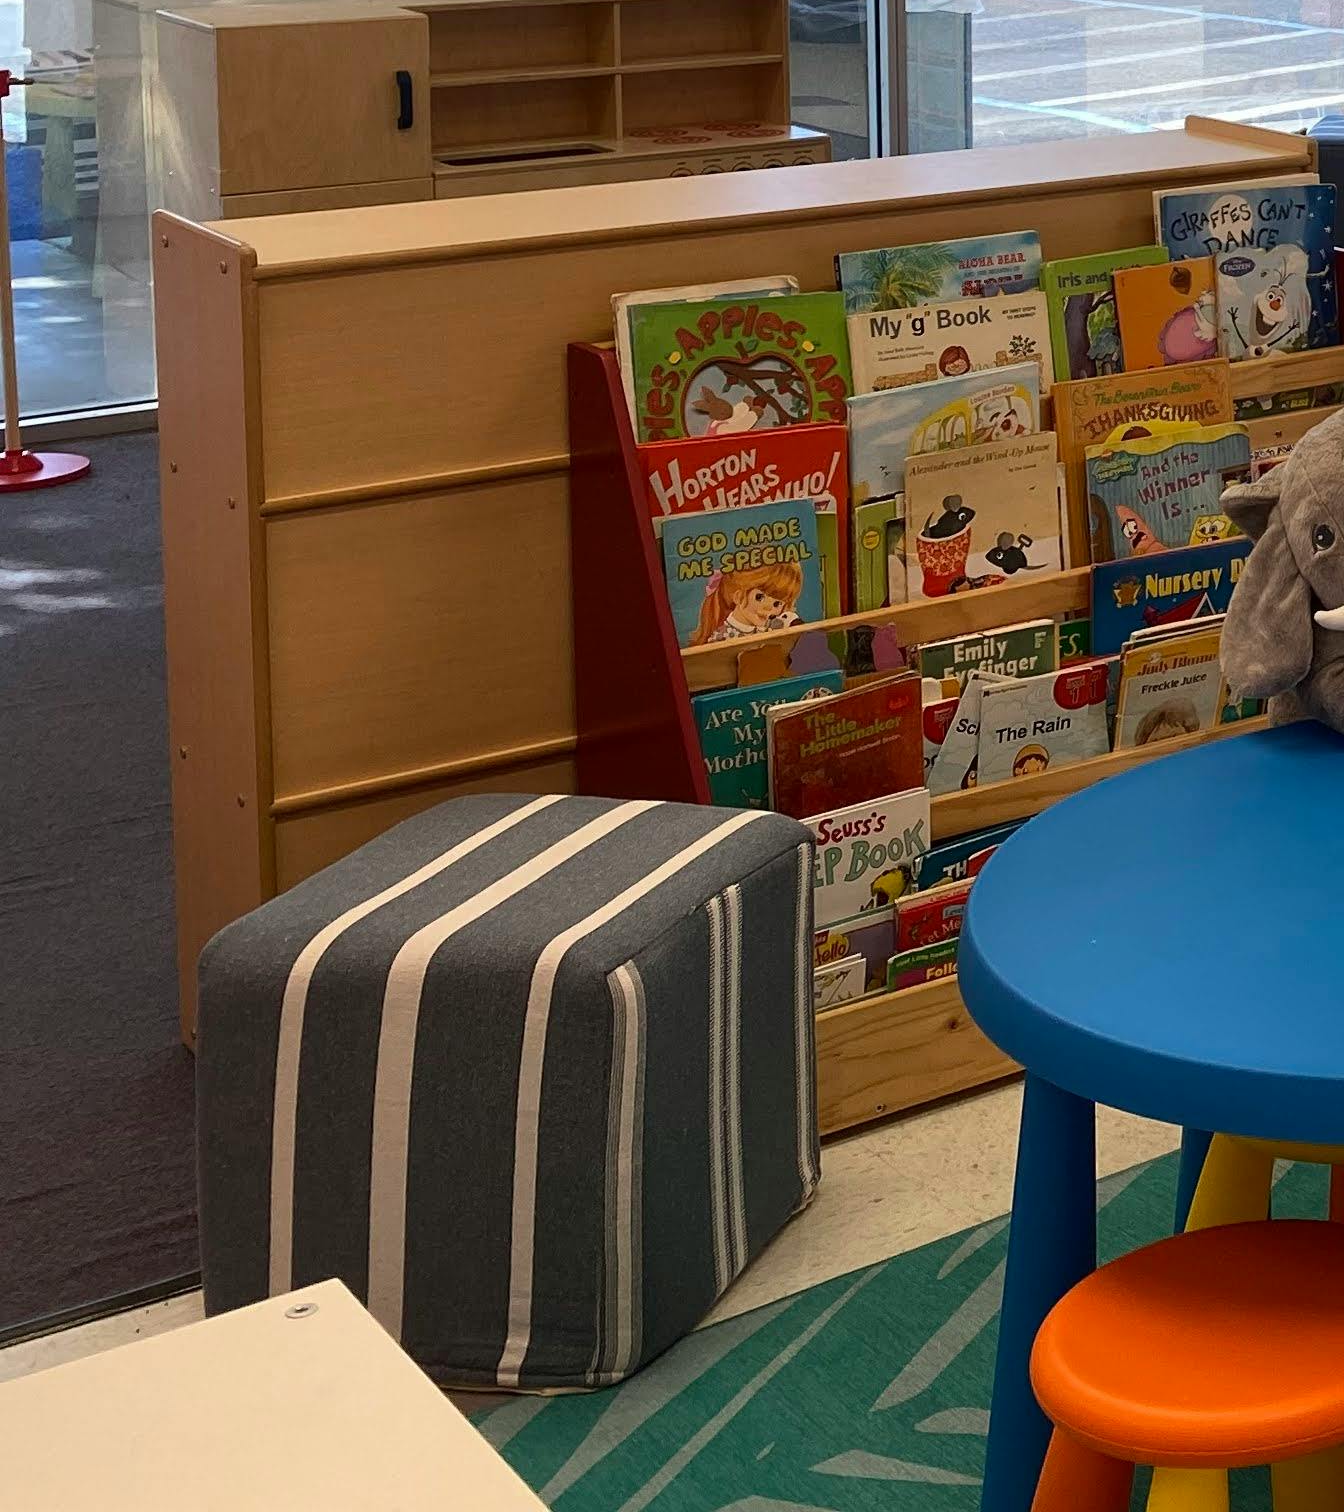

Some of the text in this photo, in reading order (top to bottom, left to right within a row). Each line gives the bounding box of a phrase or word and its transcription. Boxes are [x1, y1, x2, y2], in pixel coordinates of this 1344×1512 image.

[1170, 198, 1306, 242] GIRAFFES CAN'T
[1203, 227, 1280, 256] DANCE
[997, 252, 1026, 266] BEAR
[1057, 271, 1107, 288] Iris and
[870, 316, 902, 339] My
[936, 305, 992, 330] Book
[1083, 399, 1221, 440] THANKSGIVING
[649, 448, 757, 516] HORTON
[1140, 458, 1171, 481] And
[1172, 451, 1199, 470] the
[702, 463, 780, 511] HEARS
[1136, 467, 1213, 506] Winner
[677, 518, 802, 558] GOD MADE
[678, 541, 812, 581] ME SPECIAL
[1144, 566, 1223, 599] Nursery
[953, 638, 1008, 664] Emily
[1140, 672, 1207, 695] Freckle Juice
[704, 708, 743, 730] Are
[732, 723, 767, 746] My
[803, 712, 836, 729] The
[815, 718, 857, 742] Little
[996, 717, 1071, 744] The Rain
[800, 716, 902, 758] Homemaker
[816, 811, 887, 847] Seuss's
[844, 818, 927, 883] BOOK
